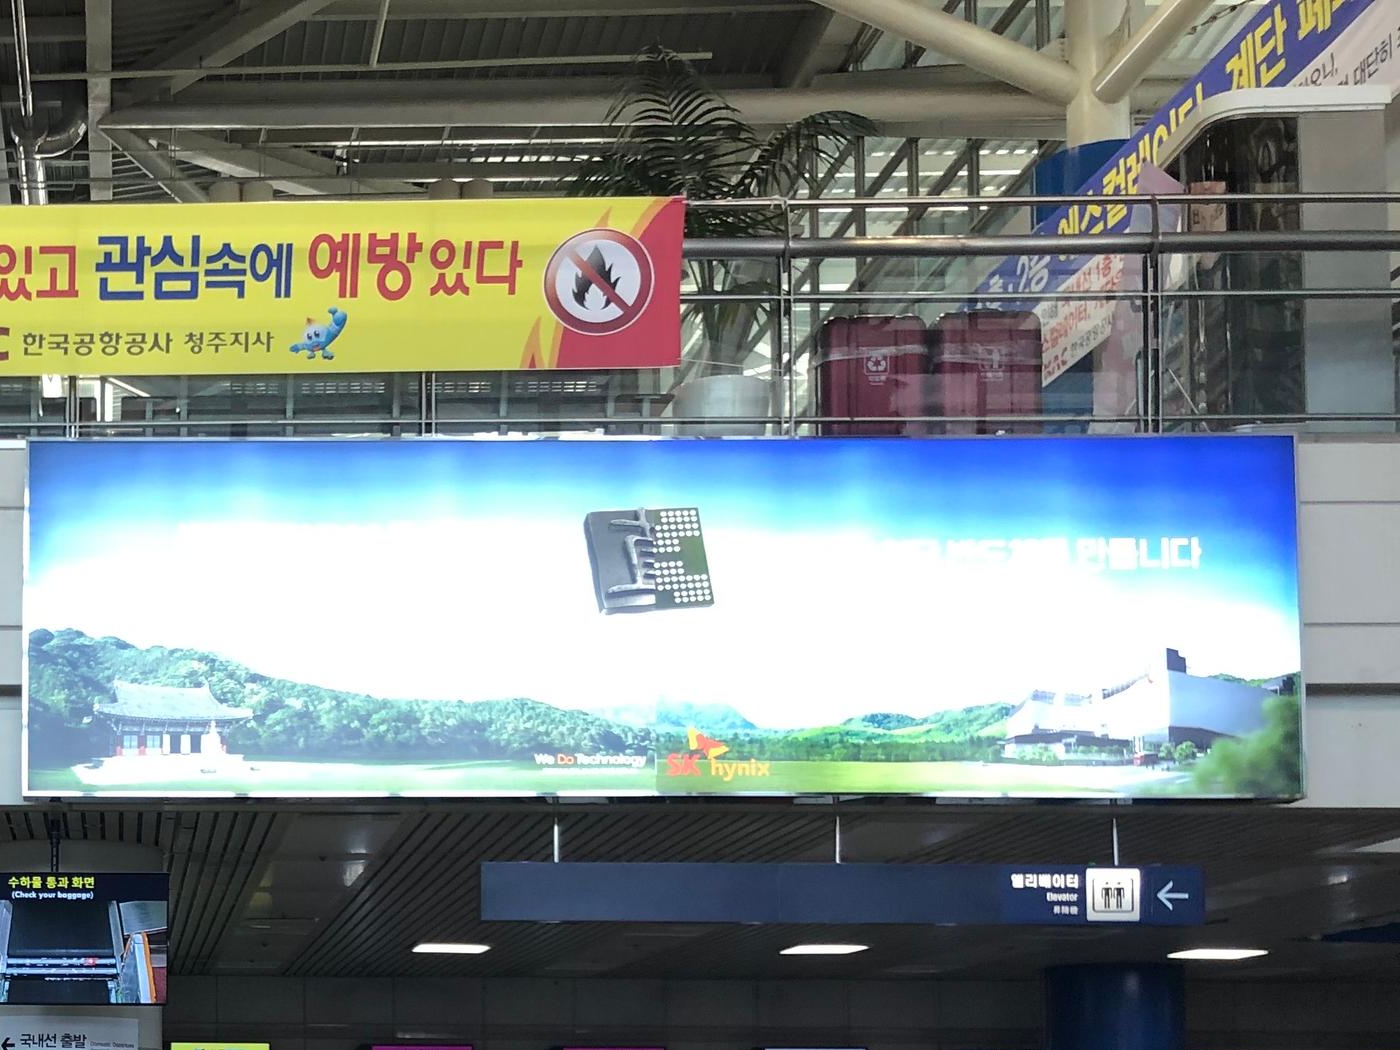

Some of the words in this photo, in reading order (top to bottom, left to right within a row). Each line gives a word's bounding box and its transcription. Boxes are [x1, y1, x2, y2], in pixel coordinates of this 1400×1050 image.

[94, 234, 294, 300] 관심속에
[22, 330, 173, 357] 한국공항공사
[184, 329, 274, 354] 청주지사
[557, 753, 574, 765] Do
[665, 752, 701, 776] SK
[710, 758, 770, 782] hynix
[8, 876, 43, 890] 수하물
[71, 876, 95, 890] 화면
[38, 891, 56, 901] your
[20, 1033, 57, 1048] 국내선
[60, 1033, 87, 1049] 출발
